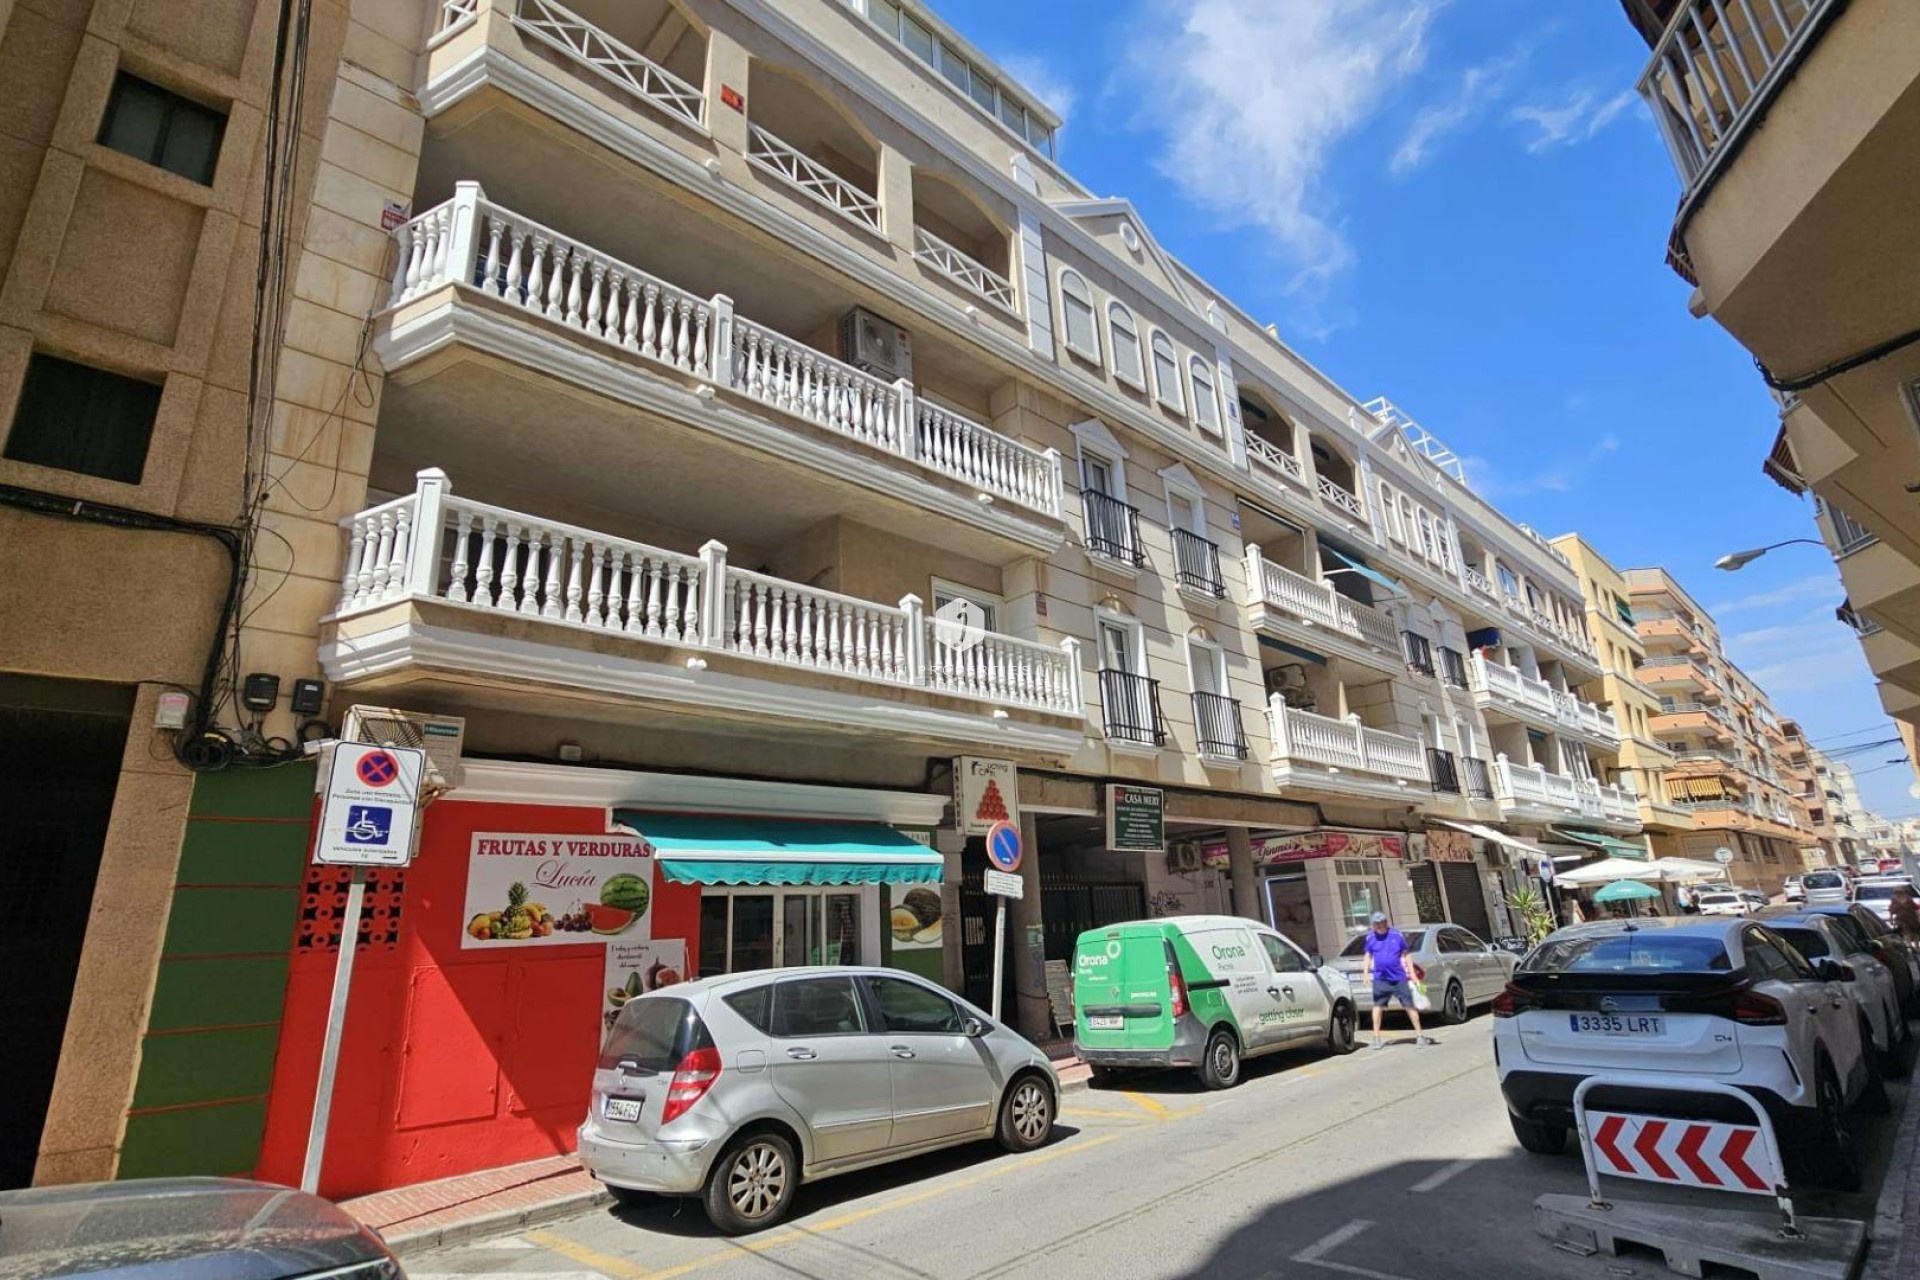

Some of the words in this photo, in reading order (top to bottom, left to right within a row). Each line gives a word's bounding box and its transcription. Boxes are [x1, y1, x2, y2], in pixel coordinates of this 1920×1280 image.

[1125, 793, 1142, 805] CASA
[477, 839, 547, 856] FRUTAS
[552, 841, 563, 857] Y
[567, 842, 650, 858] VERDURAS
[1212, 945, 1245, 960] Orona
[1079, 954, 1108, 967] Orona
[1259, 1008, 1284, 1025] getting
[1285, 1006, 1304, 1019] closer
[1580, 1016, 1622, 1031] 3335
[1628, 1018, 1660, 1032] LRT
